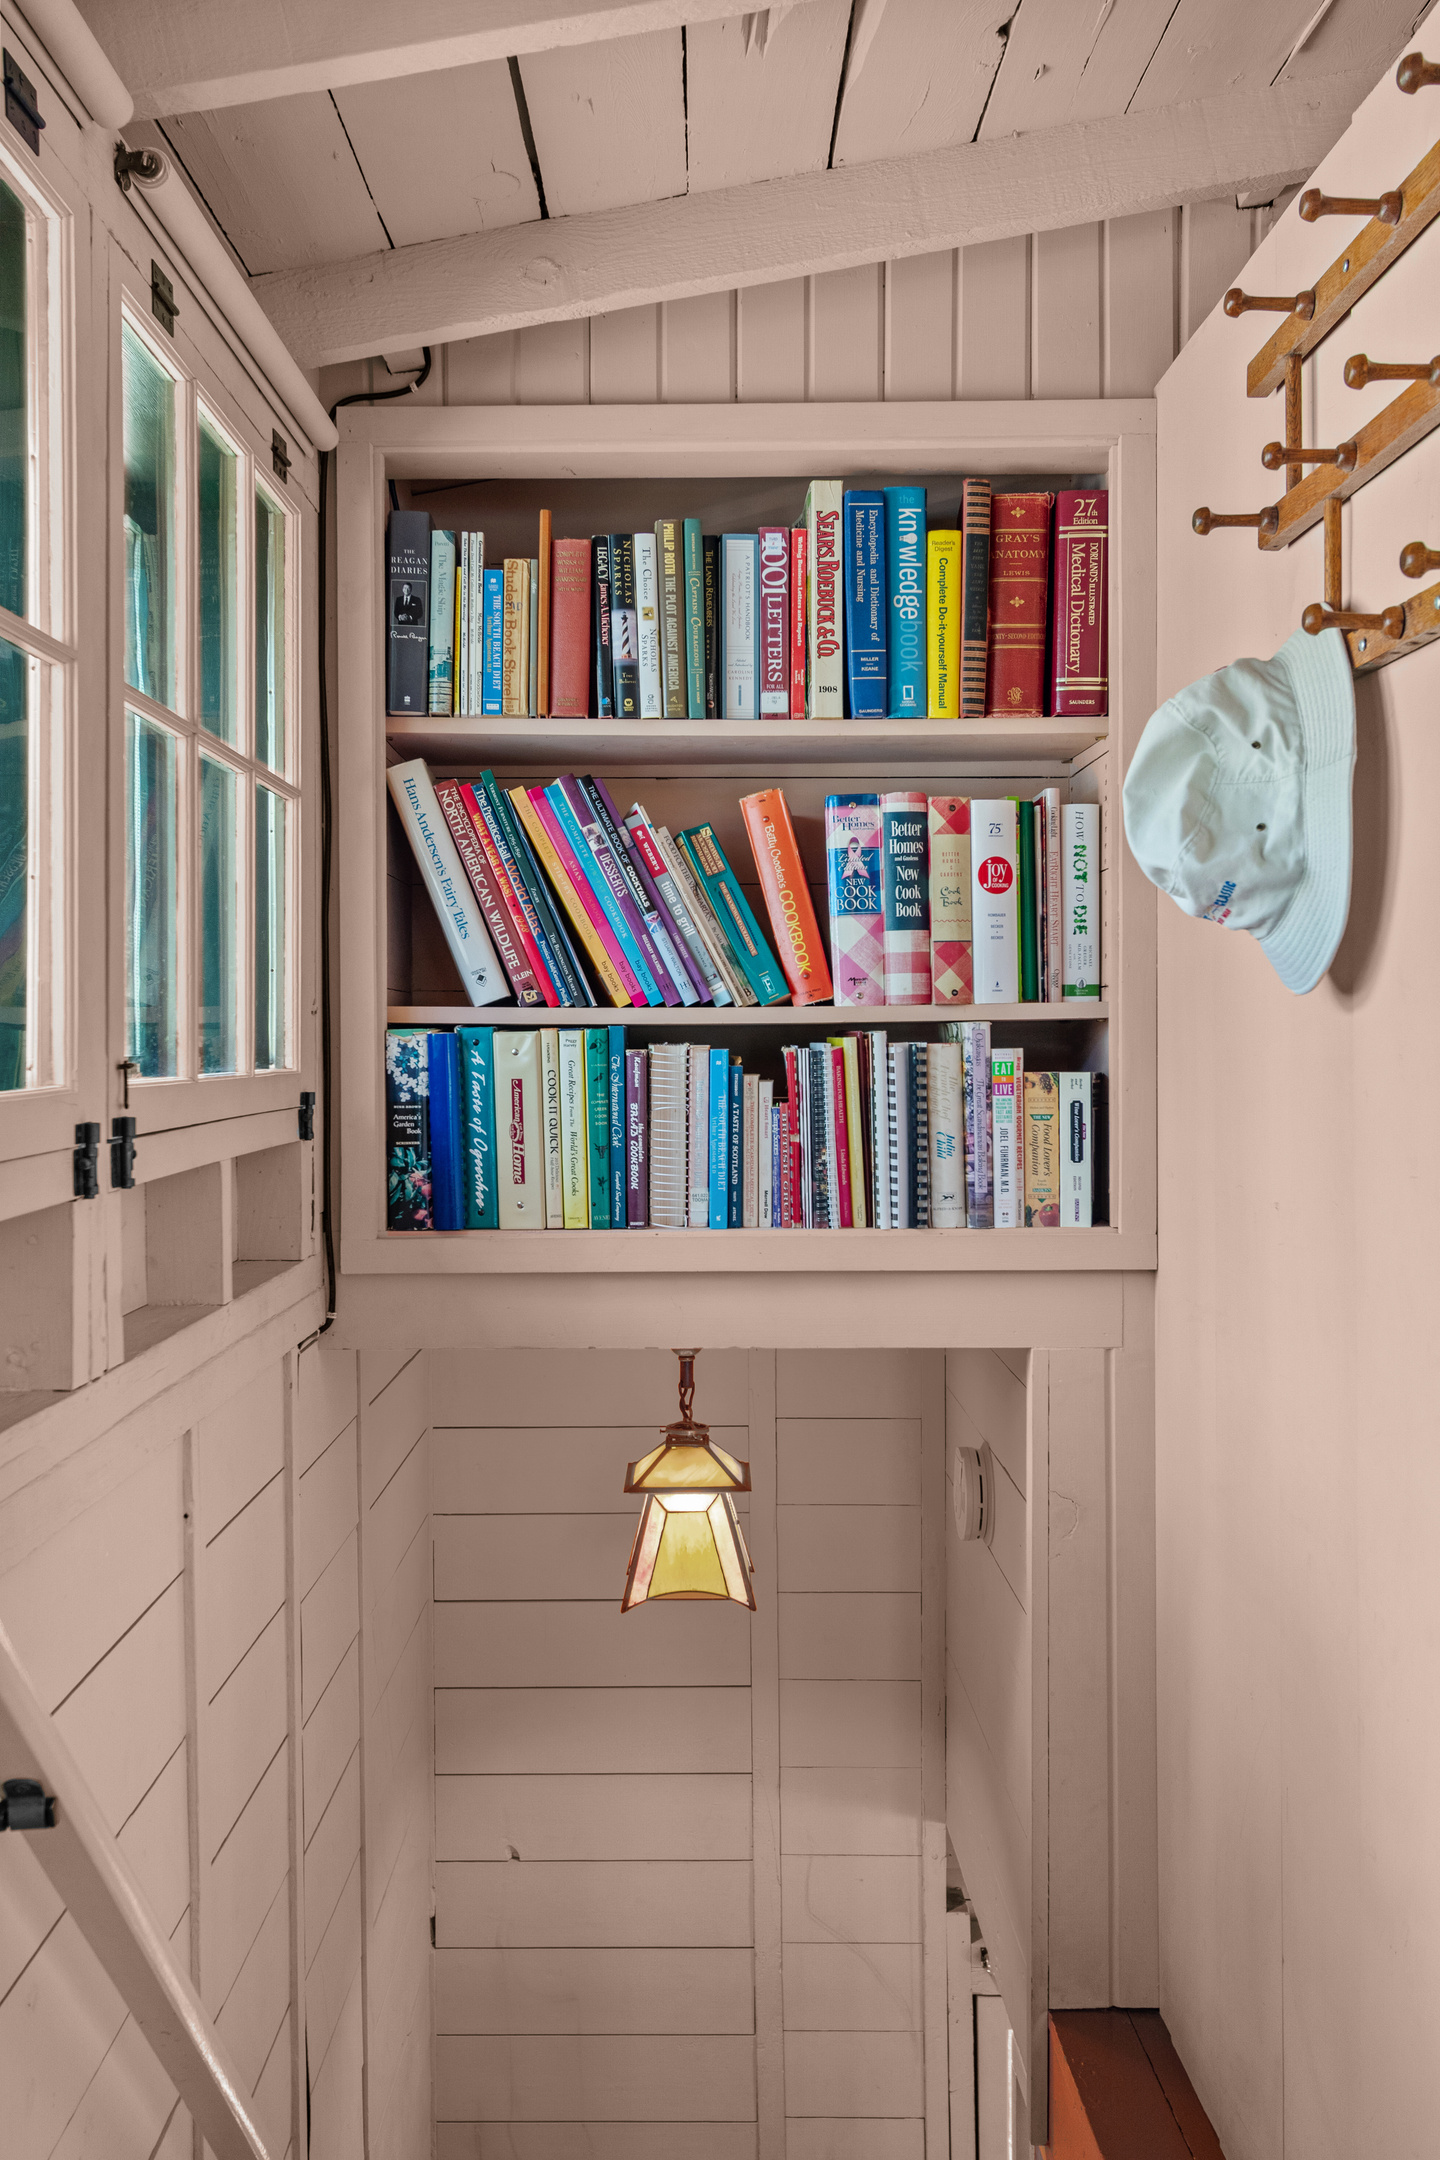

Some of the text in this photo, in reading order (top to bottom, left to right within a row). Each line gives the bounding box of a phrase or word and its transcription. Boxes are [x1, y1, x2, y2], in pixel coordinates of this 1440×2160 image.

[899, 495, 915, 504] the
[815, 510, 840, 560] SEARS,
[1073, 517, 1098, 525] Edition
[995, 534, 1040, 543] GRAY'S
[391, 557, 428, 565] REAGAN
[391, 566, 428, 575] DIARIES
[597, 546, 608, 581] LEGACY
[613, 548, 622, 596] SPARKS
[623, 540, 632, 604] NICHOLAS
[855, 509, 865, 602] Medicine and Nursing
[436, 553, 448, 616] The Magic Ship
[642, 547, 652, 600] The Choice
[706, 550, 714, 627] THE LAND REMEMBERS
[868, 509, 880, 641] Encyclopedia and Dictionary of
[1088, 542, 1099, 625] DORLAND'S ILLUSTRATED
[598, 582, 609, 604] James
[663, 523, 679, 690] PHILIP ROTH THE PLOT AGAINST AMERICA
[817, 560, 840, 625] ROEBUCK
[1065, 542, 1086, 673] Medical Dictionary
[504, 560, 519, 696] Student Book Store
[690, 577, 702, 667] CAPTAINS COURAGEOUS
[817, 626, 834, 639] &
[937, 557, 949, 709] Complete Do-it-yourself Manual
[493, 595, 501, 690] THE SOUTH BEACH DIET
[641, 634, 650, 667] SPARKS
[649, 628, 657, 673] NICHOLAS
[818, 685, 838, 693] 1908
[449, 786, 487, 865] THE ENCYCLOPEDIA OF
[832, 815, 861, 824] Better
[842, 822, 875, 831] Homes
[891, 820, 923, 837] Better
[402, 776, 470, 940] Hans Andersen's Fairy Tales
[472, 813, 513, 898] WHAT A YEAR IT WAS!
[475, 788, 542, 937] The Prentice-Hall World Atlas
[588, 784, 598, 801] THE
[595, 800, 614, 833] ULTIMATE
[610, 831, 625, 854] BOOK
[620, 854, 630, 866] OF
[626, 865, 650, 908] COCKTAILS
[642, 842, 661, 871] WEBER'S
[889, 838, 924, 854] Homes
[438, 789, 466, 837] NORTH
[458, 837, 496, 909] AMERICAN
[488, 908, 521, 970] WILDLIFE
[523, 803, 594, 942] THE COMPLETE STIR-FRY COOKBOOK
[599, 852, 629, 898] DESSERTS
[845, 878, 865, 886] NEW
[896, 865, 920, 882] New
[983, 859, 1008, 888] joy
[1073, 811, 1088, 935] HOW NOT TO DIE
[660, 880, 679, 904] time
[763, 822, 777, 849] Betty
[770, 847, 786, 889] Crocker's
[778, 889, 813, 976] COOKBOOK
[834, 885, 877, 898] COOK
[836, 897, 878, 911] BOOK
[895, 883, 922, 900] Cook
[1214, 881, 1237, 906] CLASSIC
[672, 903, 685, 916] to
[895, 902, 923, 917] Book
[676, 915, 696, 938] grill
[511, 969, 534, 983] KLEIN
[601, 961, 620, 993] bay books
[619, 961, 637, 993] bay books
[634, 959, 653, 992] bay books
[633, 1055, 641, 1086] Kaufman
[977, 1078, 985, 1090] The
[993, 1062, 1012, 1075] EAT
[512, 1078, 523, 1122] American
[976, 1091, 985, 1108] Great
[994, 1083, 1013, 1095] LIVE
[547, 1068, 559, 1153] COOK IT QUICK
[468, 1048, 489, 1208] A Taste of Ogeechee
[732, 1134, 739, 1143] OF
[976, 1108, 986, 1151] Scandinavian
[512, 1140, 526, 1182] Home
[630, 1101, 639, 1189] BREAD COOKBOOK
[936, 1131, 947, 1159] Child
[945, 1134, 956, 1157] Julia
[1029, 1124, 1040, 1176] Companion
[1043, 1124, 1053, 1176] Food Lover's
[731, 1144, 739, 1184] SCOTLAND
[975, 1151, 986, 1174] Baking
[978, 1174, 986, 1190] Book
